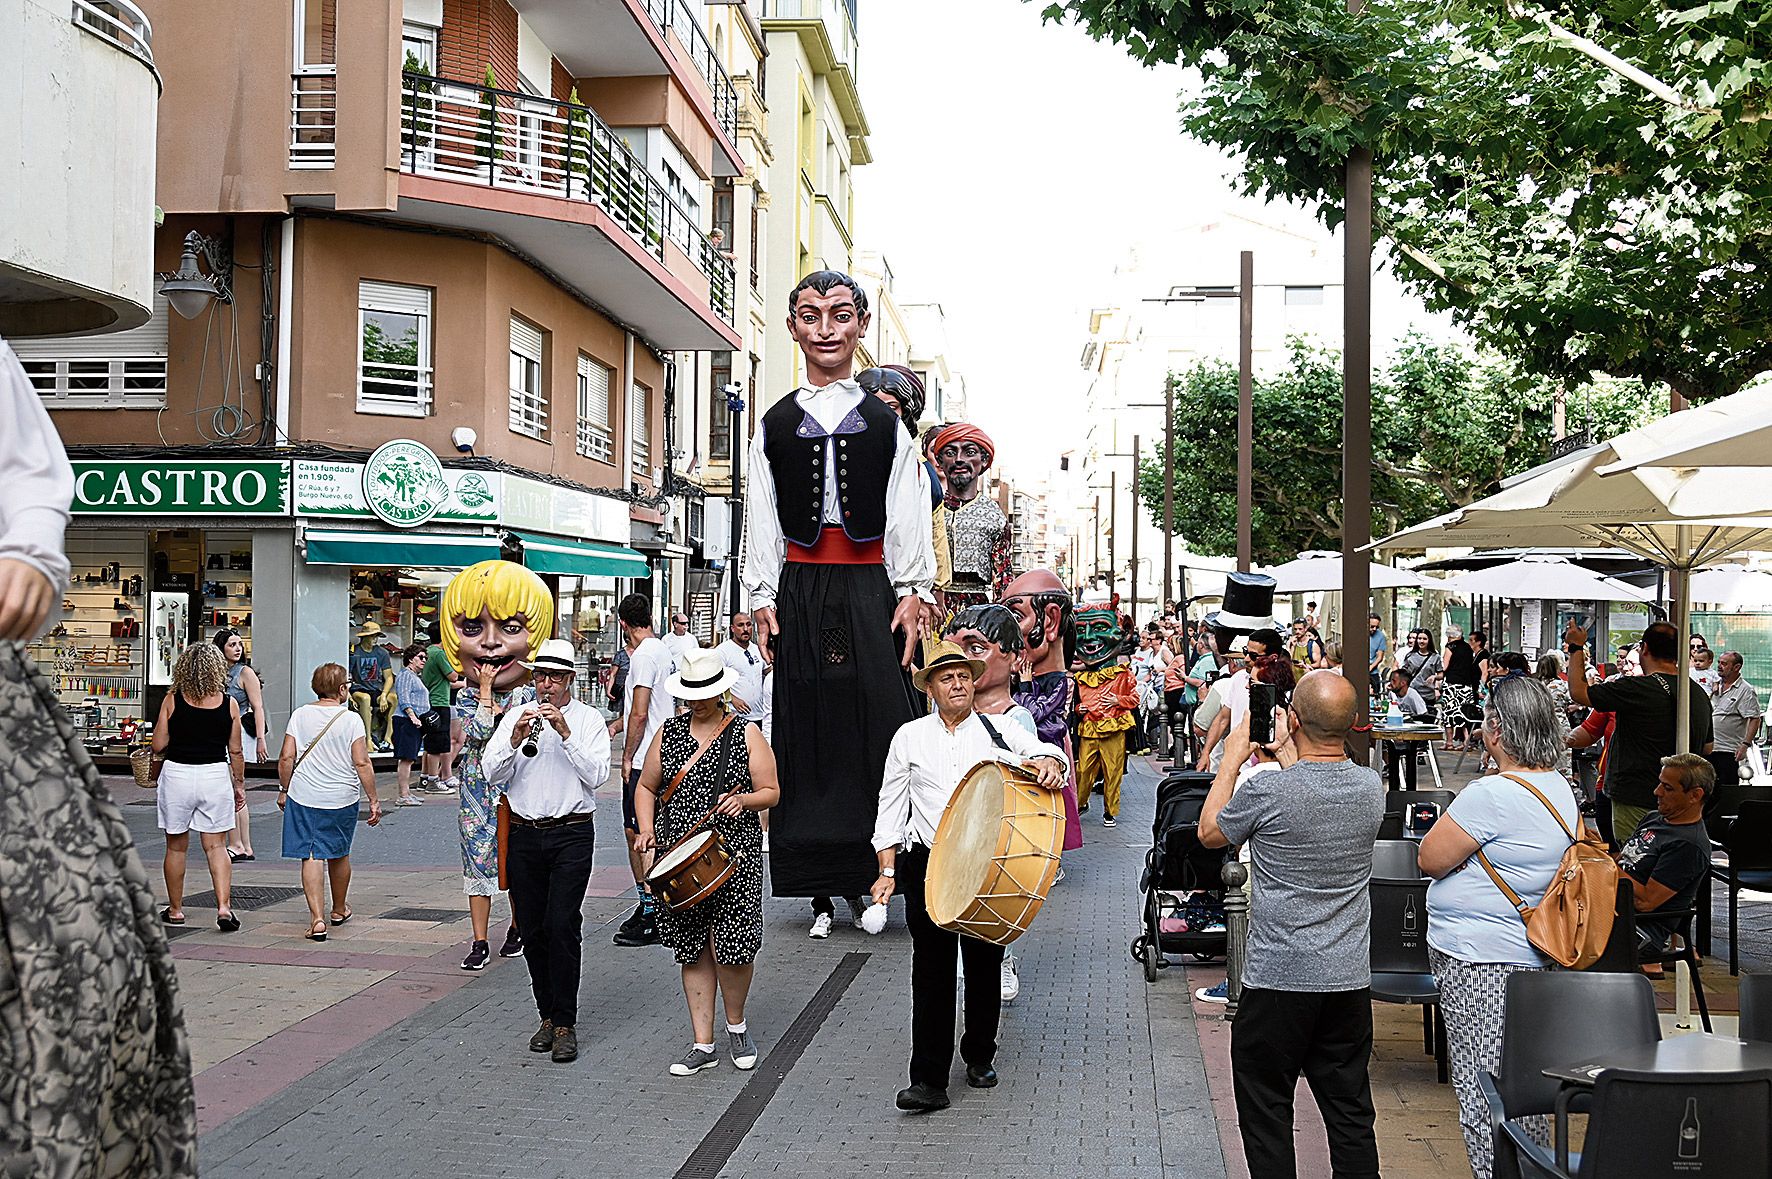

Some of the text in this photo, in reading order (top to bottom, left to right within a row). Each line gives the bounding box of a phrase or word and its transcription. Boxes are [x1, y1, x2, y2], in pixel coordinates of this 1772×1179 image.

[298, 463, 355, 473] Casa fundada
[75, 469, 267, 506] CASTRO
[298, 491, 318, 499] Burgo
[380, 501, 429, 519] CASTRO
